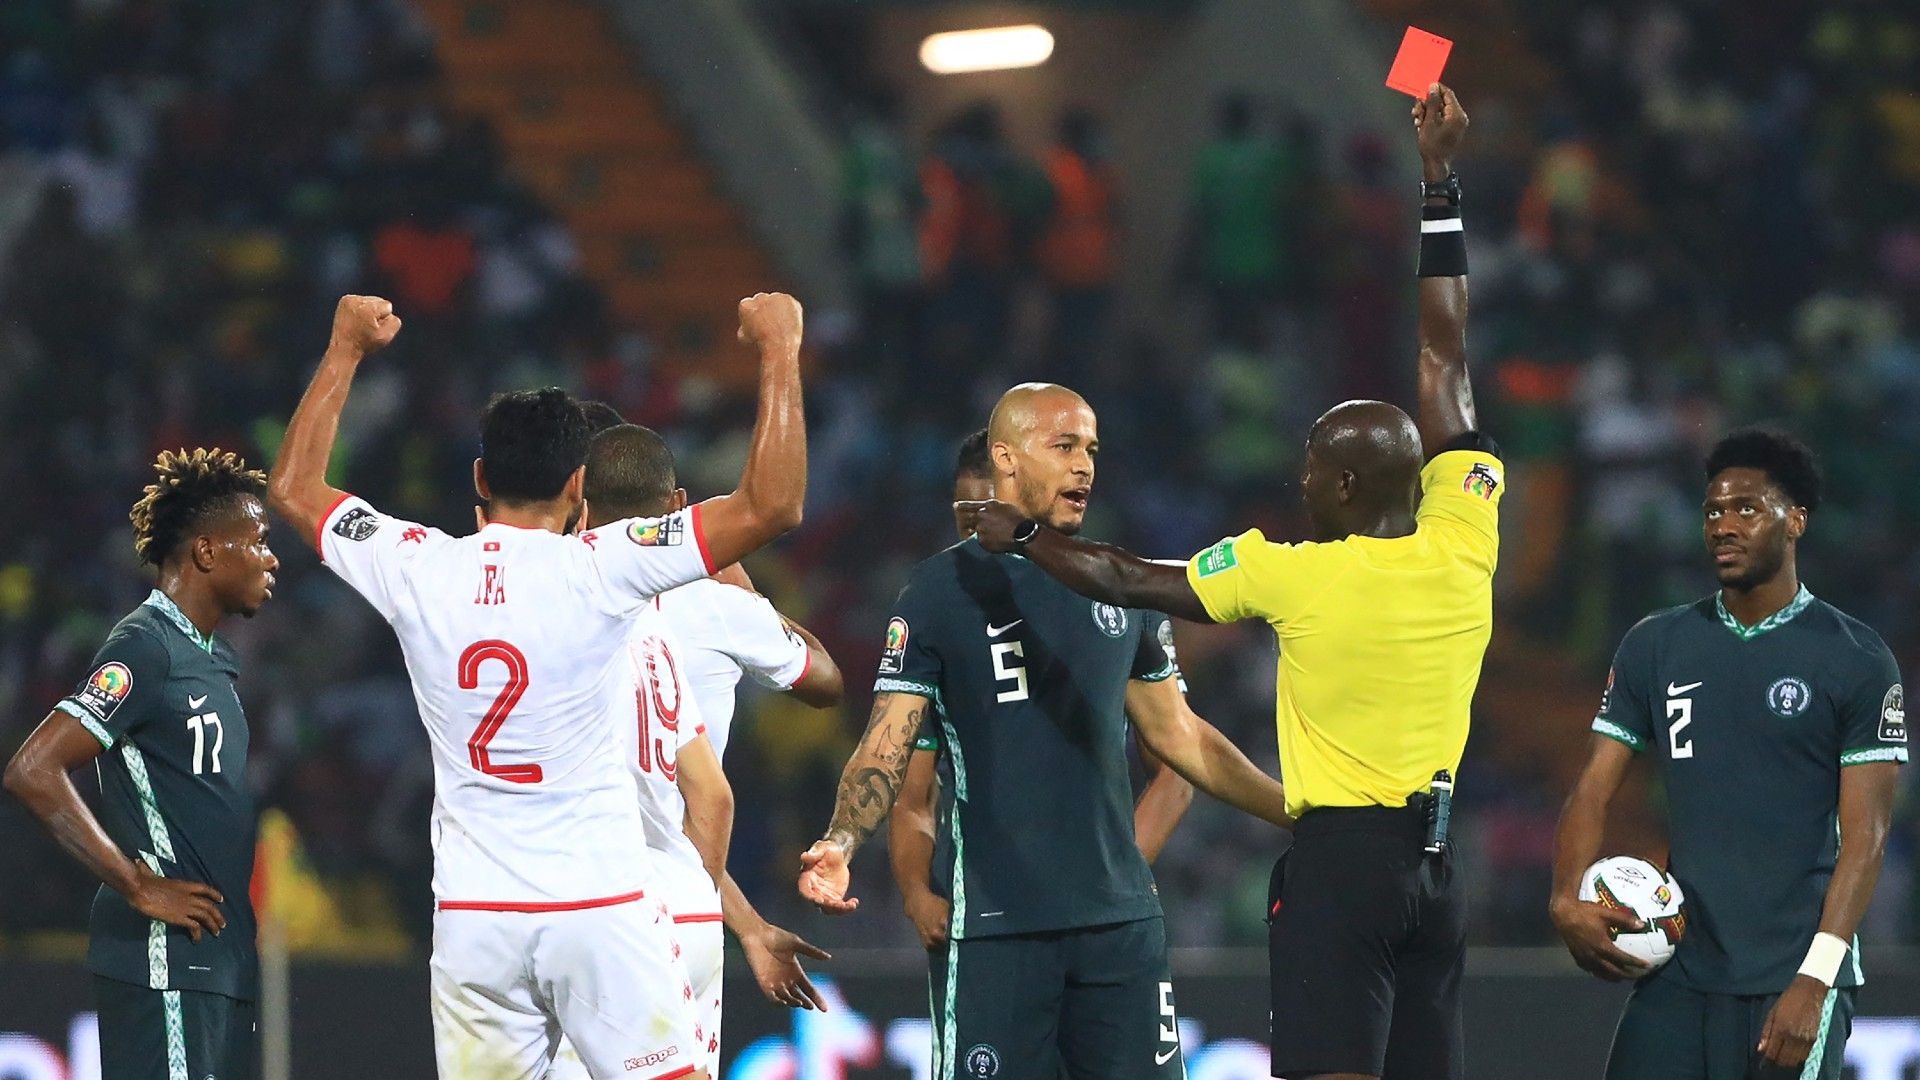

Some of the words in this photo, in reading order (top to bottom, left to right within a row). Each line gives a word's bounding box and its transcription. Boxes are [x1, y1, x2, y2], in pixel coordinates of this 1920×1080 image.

[990, 640, 1030, 703] 5
[457, 640, 543, 783] 2
[634, 635, 681, 782] 19
[1666, 698, 1694, 759] 2
[186, 713, 224, 775] 17
[1158, 981, 1178, 1043] 5
[623, 1045, 679, 1071] Kappa
